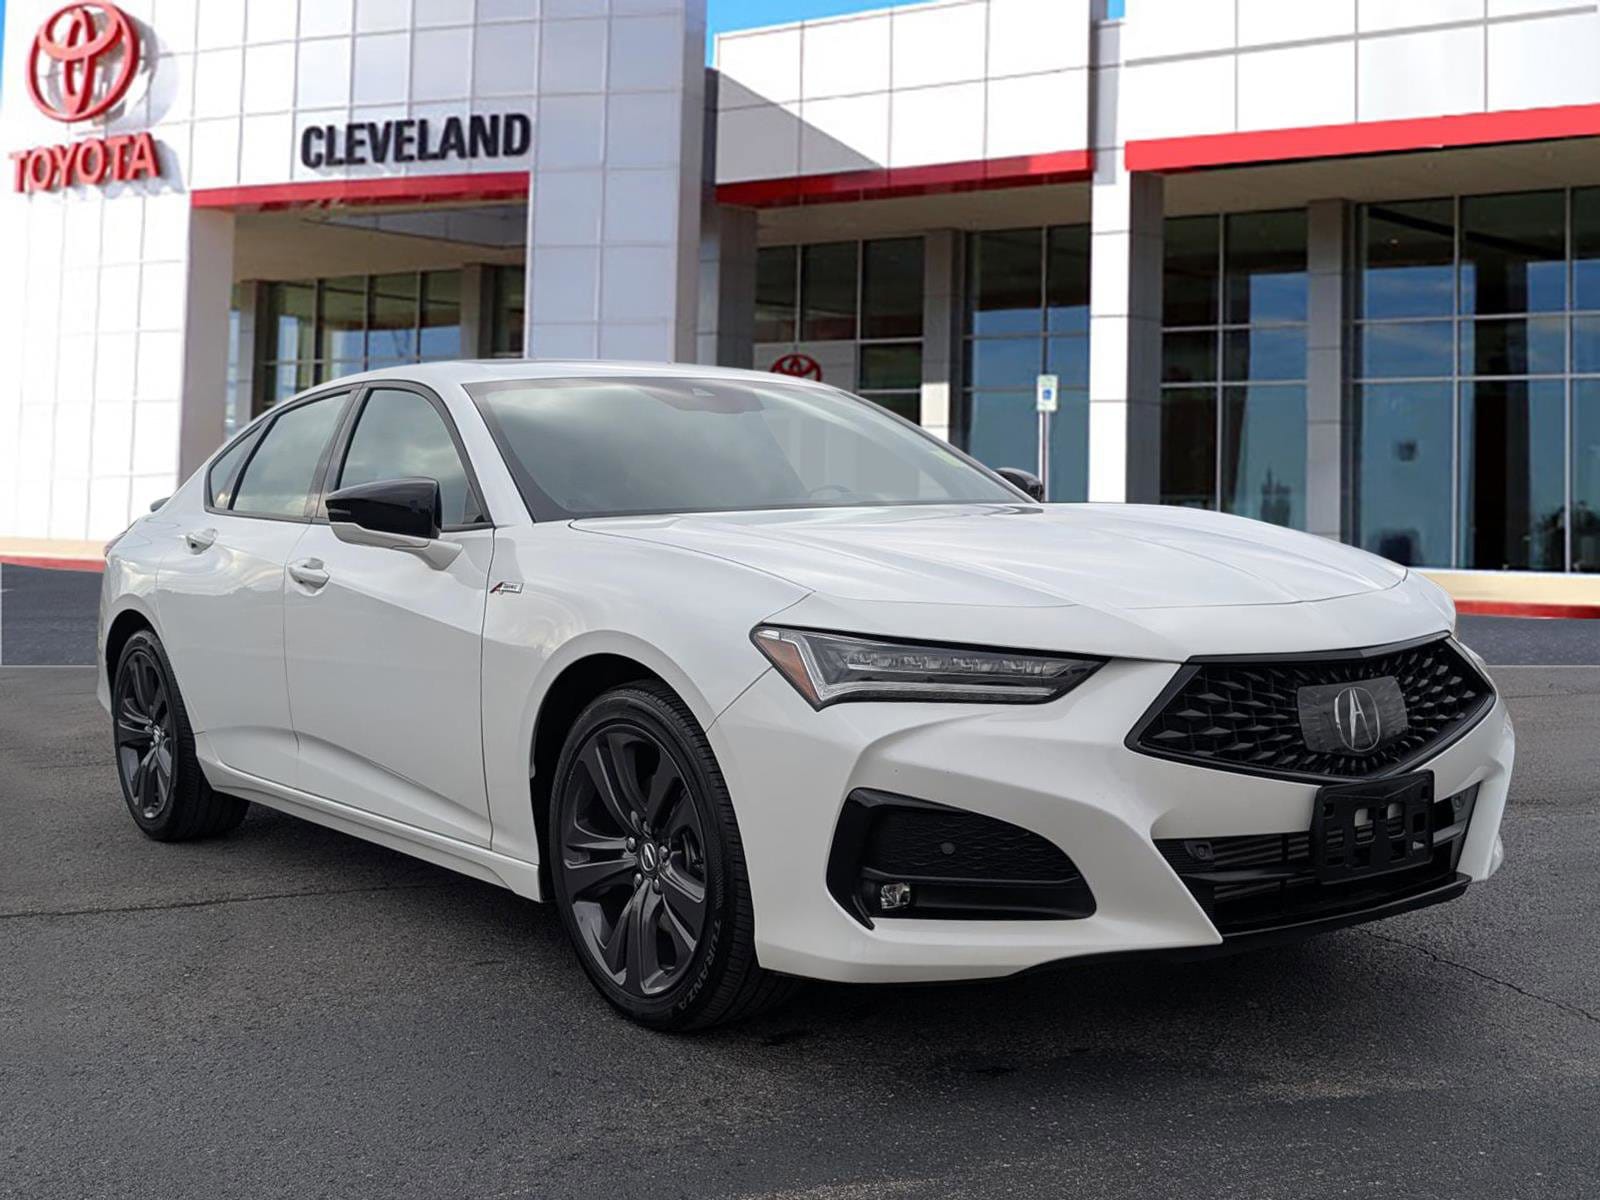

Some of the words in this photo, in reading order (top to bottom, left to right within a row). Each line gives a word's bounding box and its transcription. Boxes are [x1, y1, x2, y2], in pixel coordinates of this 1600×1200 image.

[9, 132, 160, 193] TOYOTA
[301, 113, 531, 169] CLEVELAND
[679, 919, 722, 1010] TURANZA
